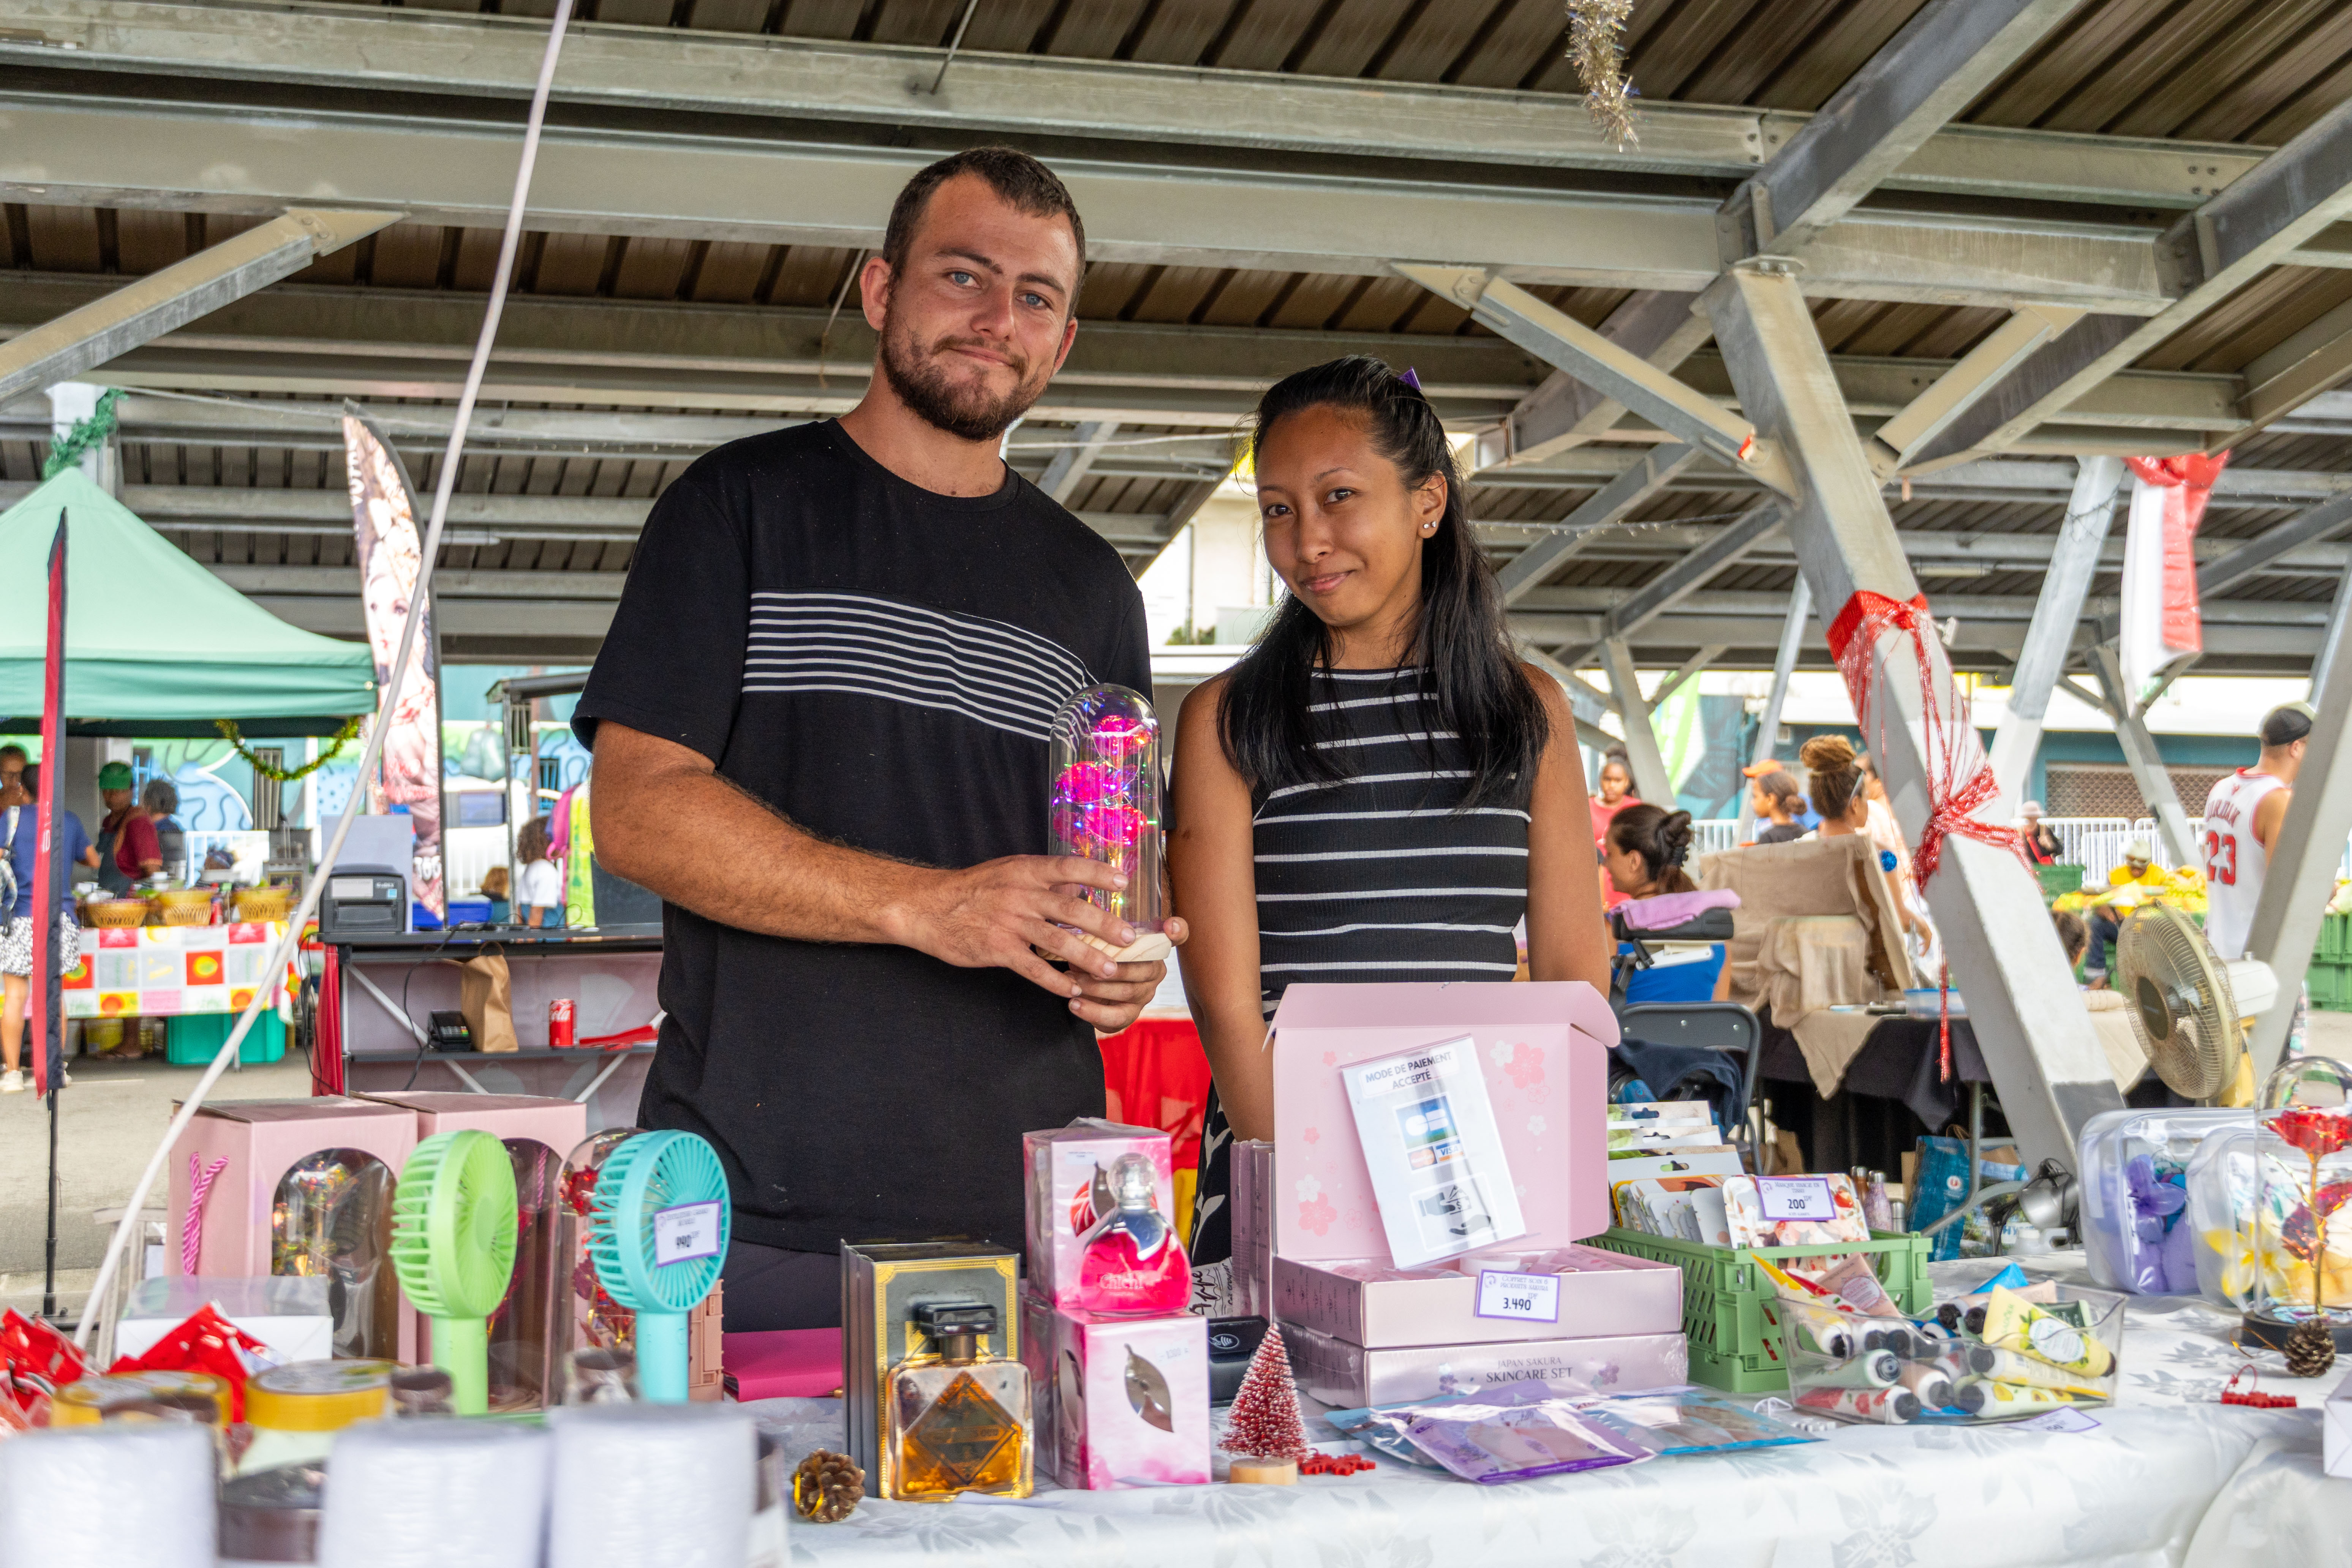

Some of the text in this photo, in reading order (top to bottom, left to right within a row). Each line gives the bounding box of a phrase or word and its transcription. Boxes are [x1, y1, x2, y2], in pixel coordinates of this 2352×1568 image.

[2205, 799, 2240, 828] JORDAN
[2205, 829, 2236, 886] 23
[1366, 1051, 1452, 1083] MODE DE PAIEMENT
[1393, 1069, 1432, 1089] ACCEPTÉ
[1441, 1145, 1459, 1155] VISA
[1787, 1199, 1805, 1209] 200
[1503, 1297, 1532, 1310] 3.490
[1498, 1356, 1562, 1369] JAPAN SAKURA
[1486, 1367, 1573, 1383] SKINCARE SET
